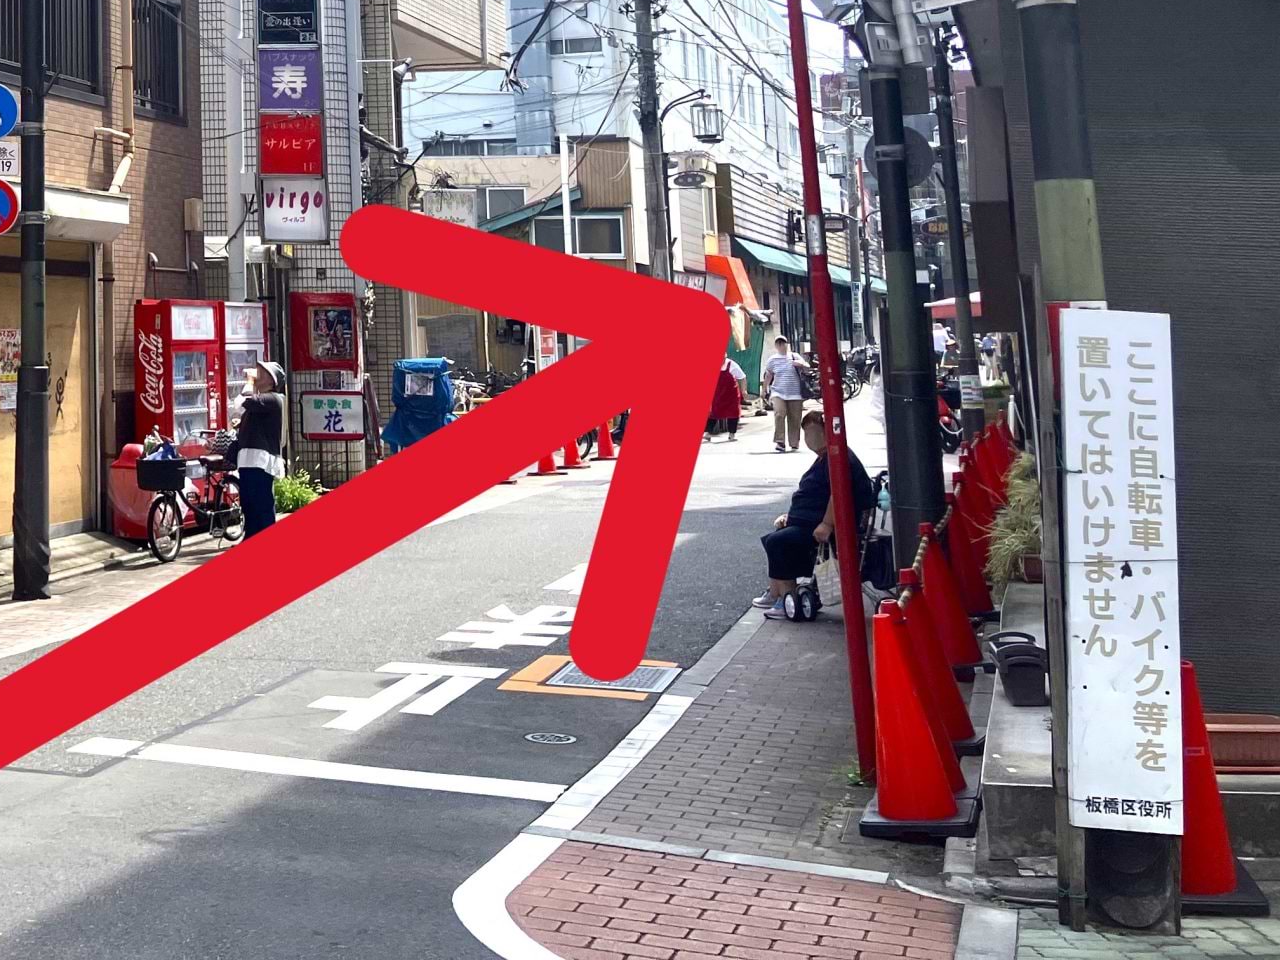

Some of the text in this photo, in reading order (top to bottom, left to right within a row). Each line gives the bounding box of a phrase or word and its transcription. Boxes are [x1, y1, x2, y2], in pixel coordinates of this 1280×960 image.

[271, 63, 308, 99] 寿
[265, 138, 316, 150] サルビア
[1, 160, 12, 172] 19
[265, 187, 324, 215] virgo
[323, 409, 345, 433] 花
[1076, 335, 1118, 659] 置いてはいけません
[1125, 340, 1168, 774] ここに自転車・バイク等を
[1085, 795, 1172, 820] 板橋区役所
